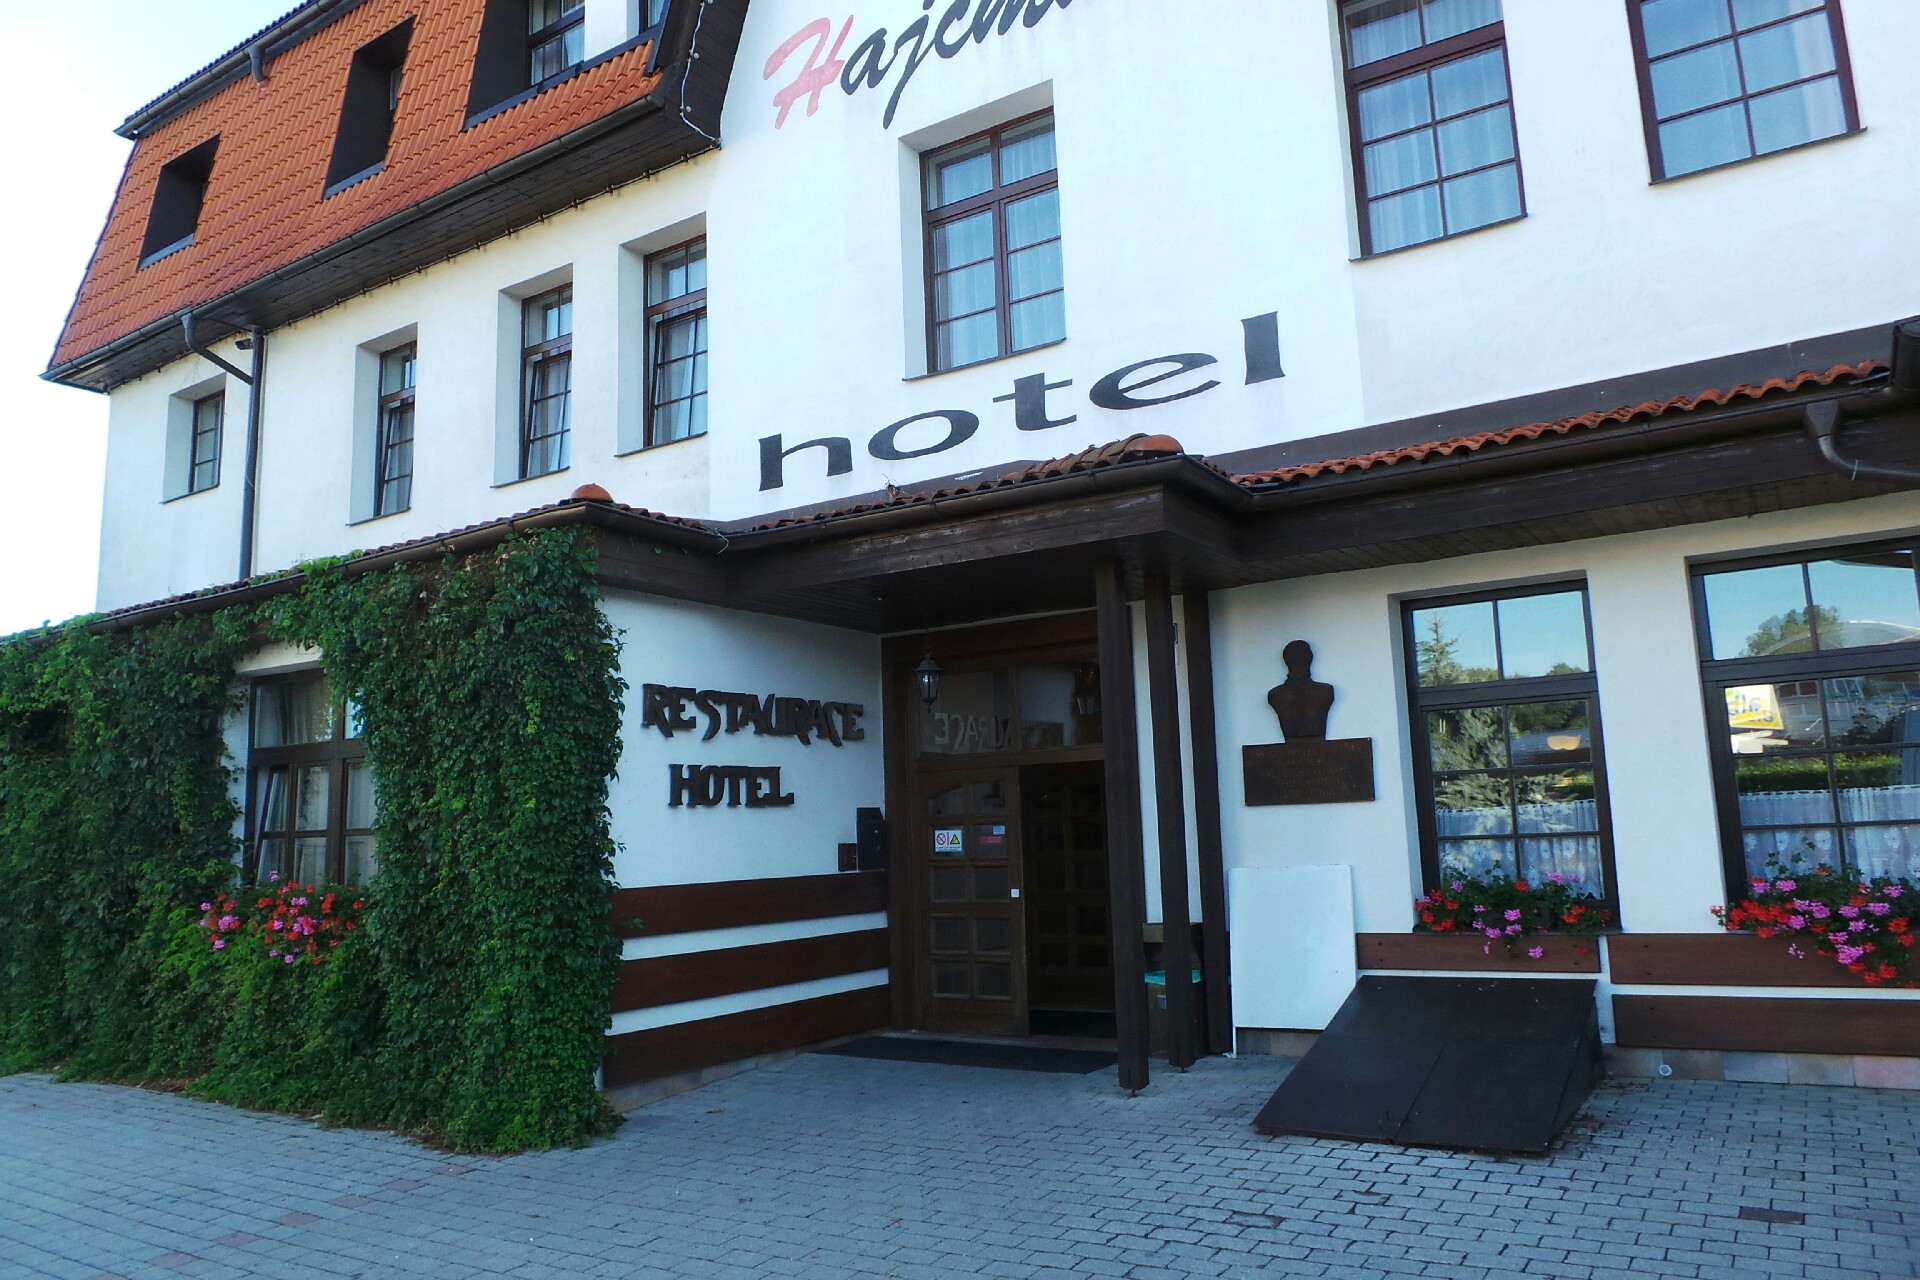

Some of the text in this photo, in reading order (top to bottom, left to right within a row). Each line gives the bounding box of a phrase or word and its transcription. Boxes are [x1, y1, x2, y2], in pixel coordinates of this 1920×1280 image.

[763, 0, 1073, 129] Hajcm
[758, 311, 1286, 491] hotel
[642, 683, 865, 747] RESTAURACE
[668, 764, 795, 808] HOTEL
